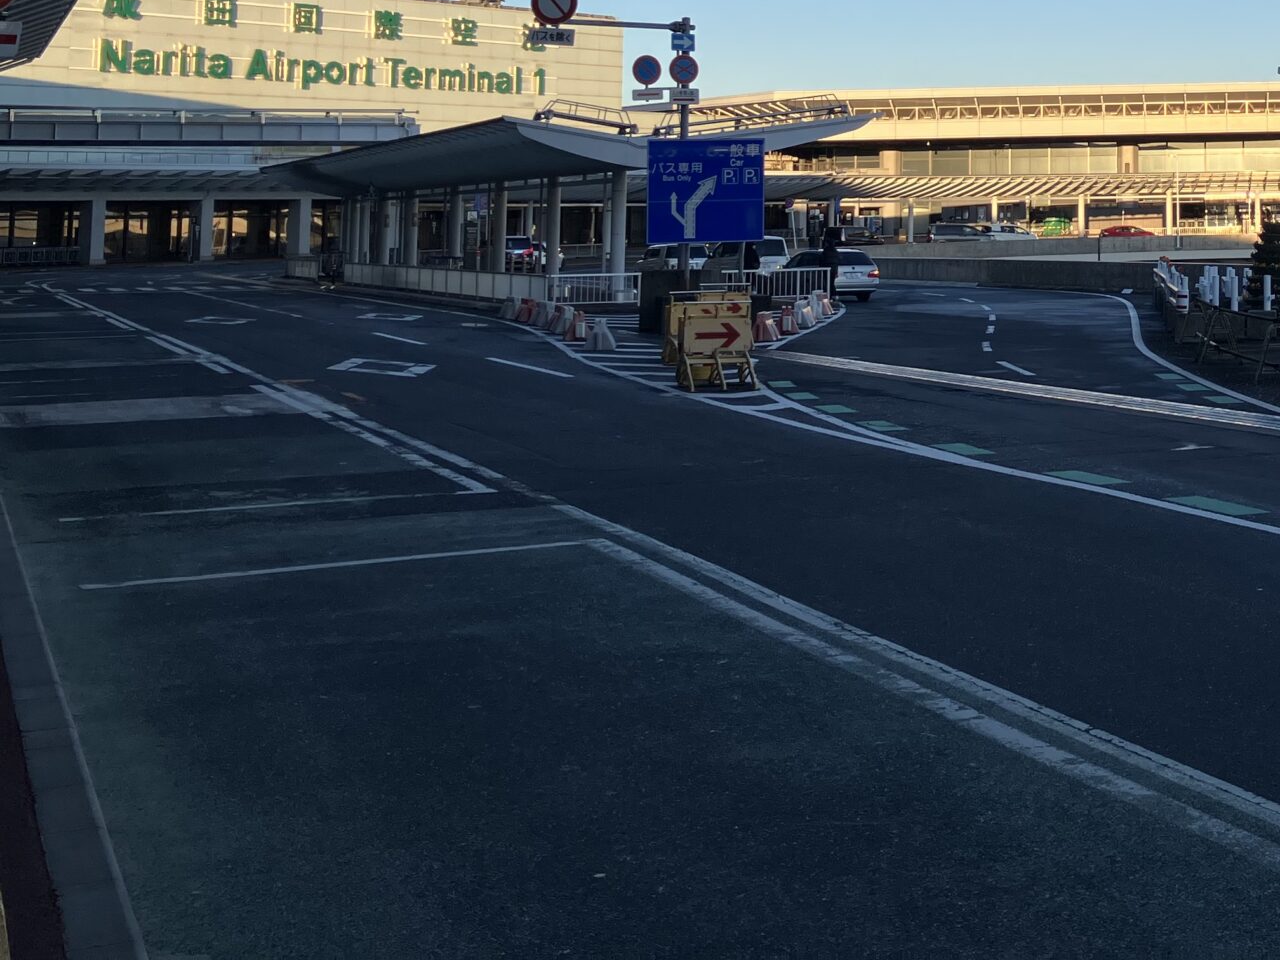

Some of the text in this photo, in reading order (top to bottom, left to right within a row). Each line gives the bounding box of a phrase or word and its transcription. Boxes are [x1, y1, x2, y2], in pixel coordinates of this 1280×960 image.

[99, 38, 546, 96] Narita Airport Terminal 1
[713, 143, 760, 157] 一般車
[652, 162, 702, 175] バス専用
[730, 158, 744, 167] Car
[677, 174, 692, 182] Only
